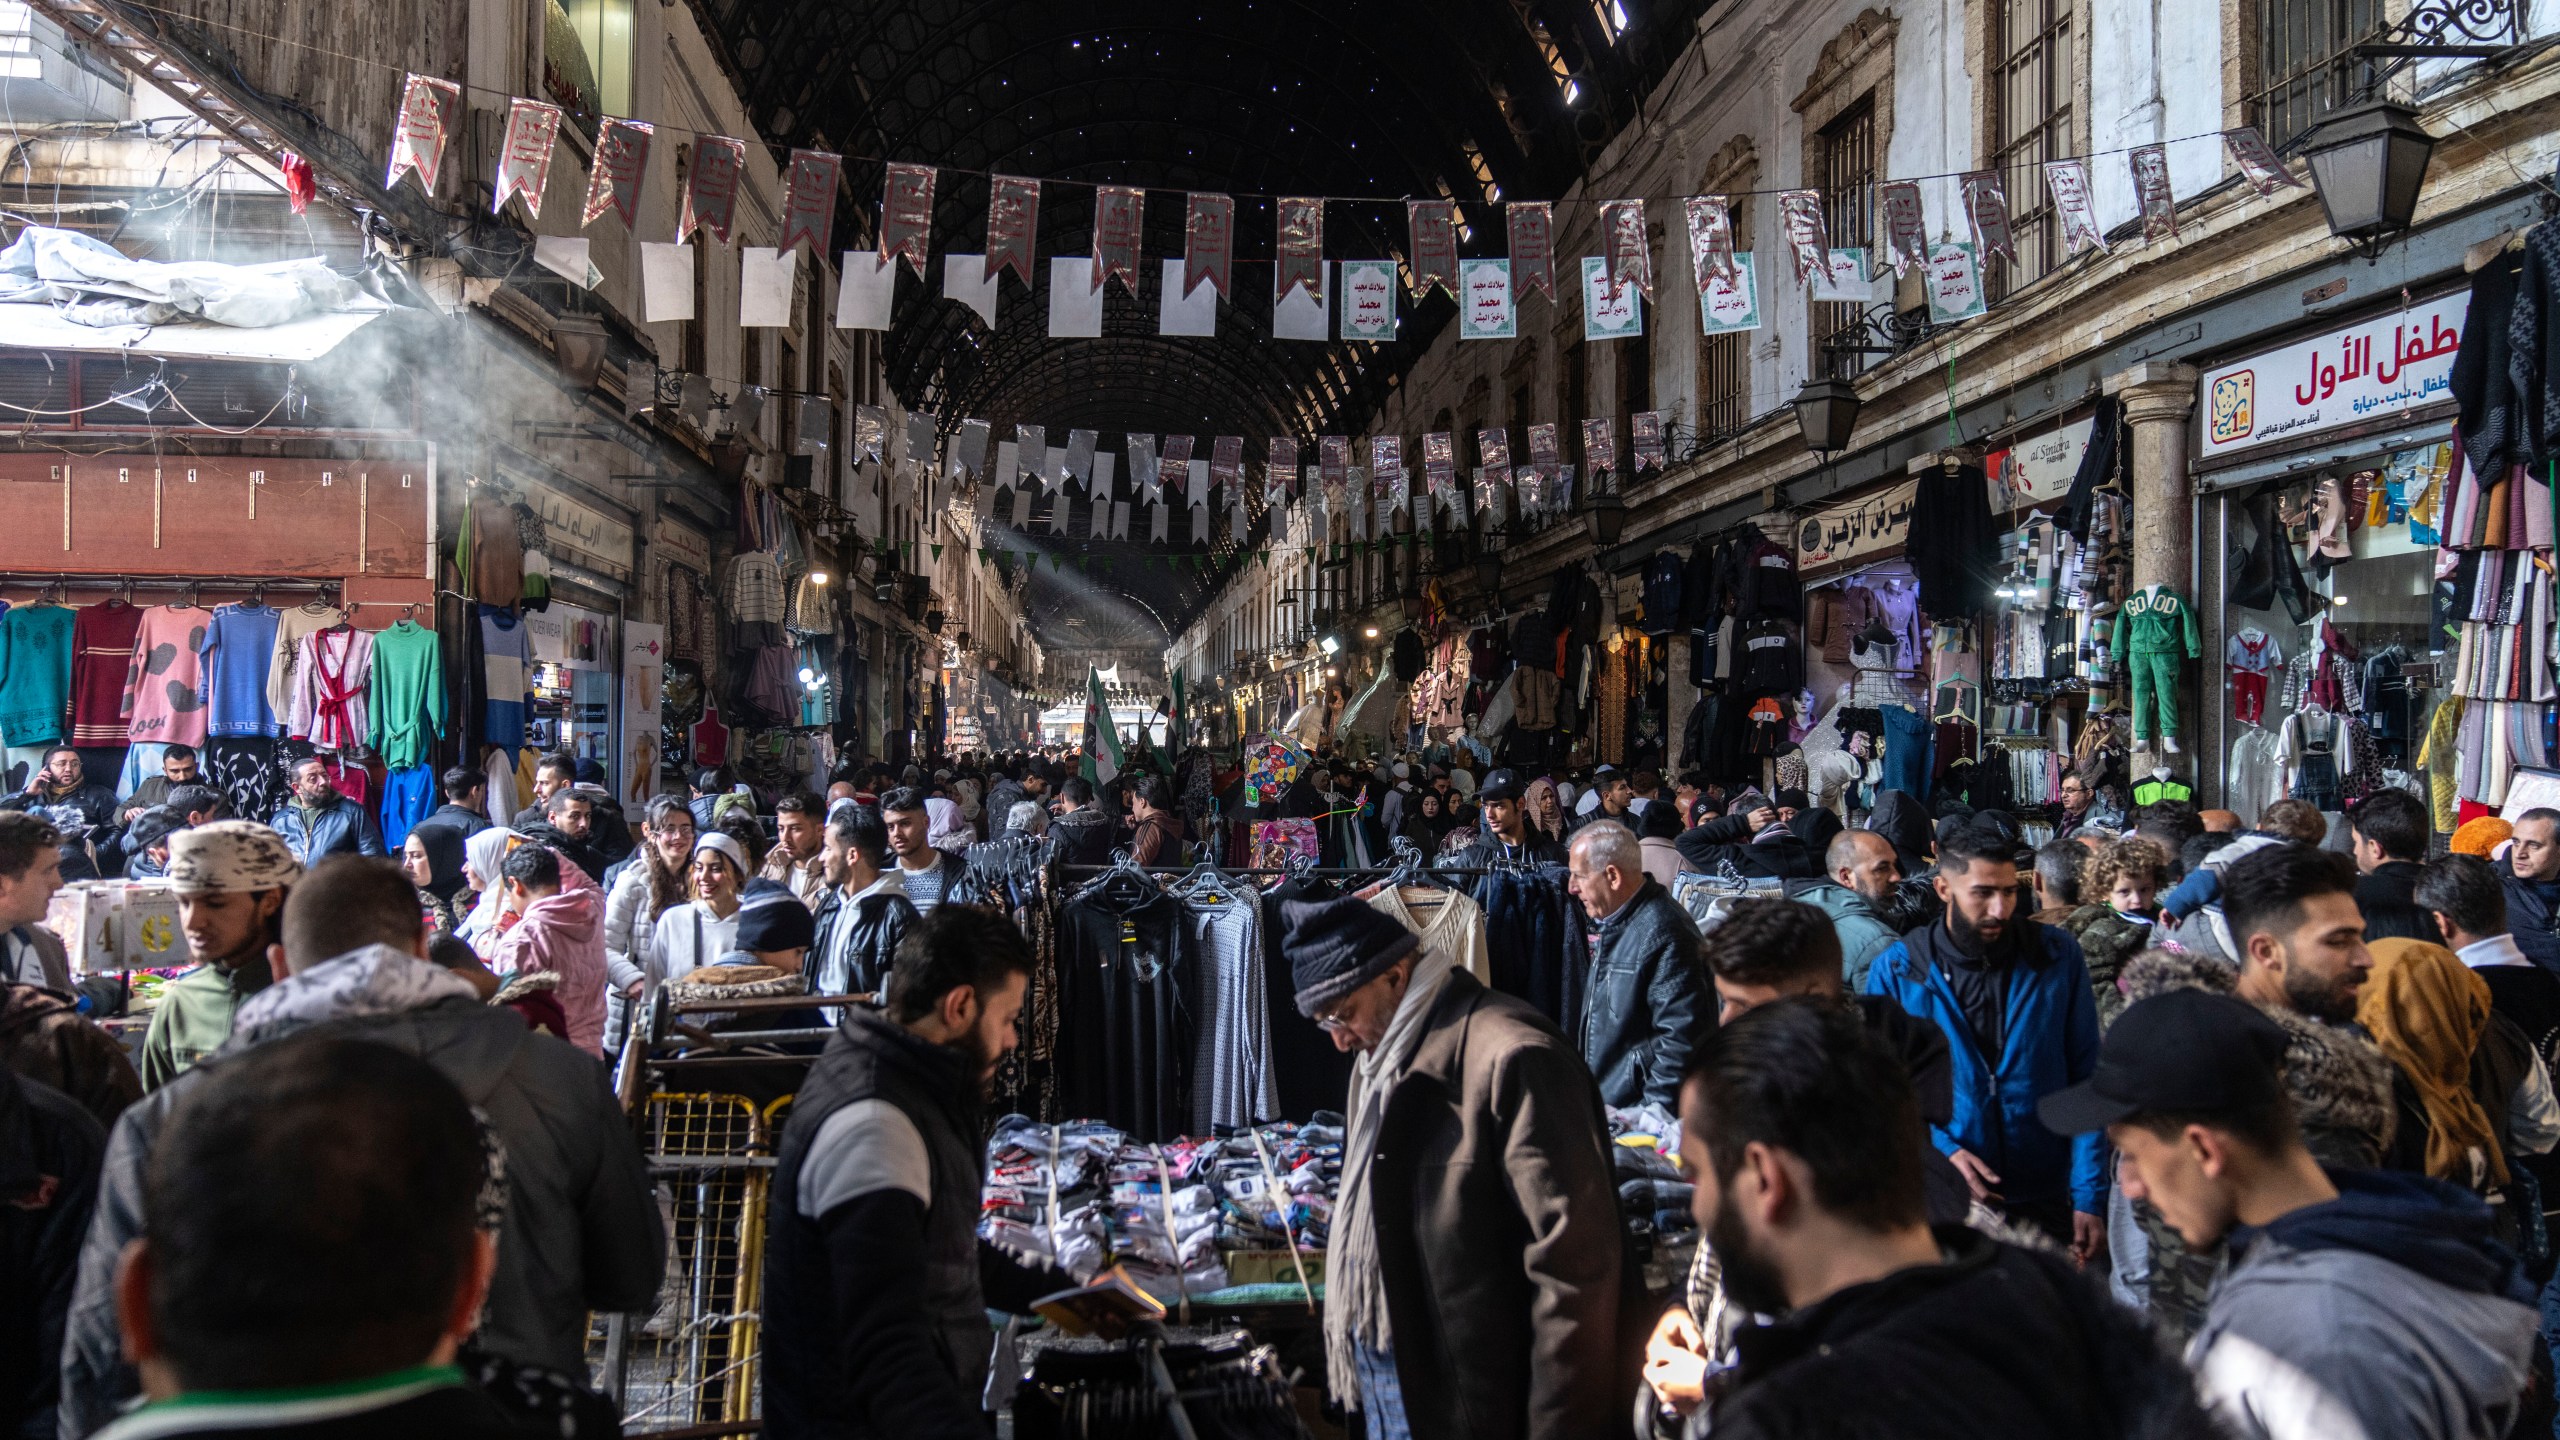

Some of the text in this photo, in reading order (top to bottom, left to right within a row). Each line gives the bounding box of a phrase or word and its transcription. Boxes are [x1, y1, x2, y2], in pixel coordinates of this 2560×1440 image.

[525, 121, 541, 132] ١٢
[2061, 177, 2075, 187] ١٢
[1896, 199, 1910, 207] ١٢
[1521, 221, 1538, 231] ١٢
[1702, 216, 1715, 225] ١٢
[2296, 314, 2460, 406] طفل الأول
[2353, 396, 2379, 414] ديارة
[2307, 409, 2320, 424] أبناء
[2279, 418, 2296, 432] العزيز
[2296, 418, 2306, 428] عبد
[1824, 507, 1866, 552] الزهور
